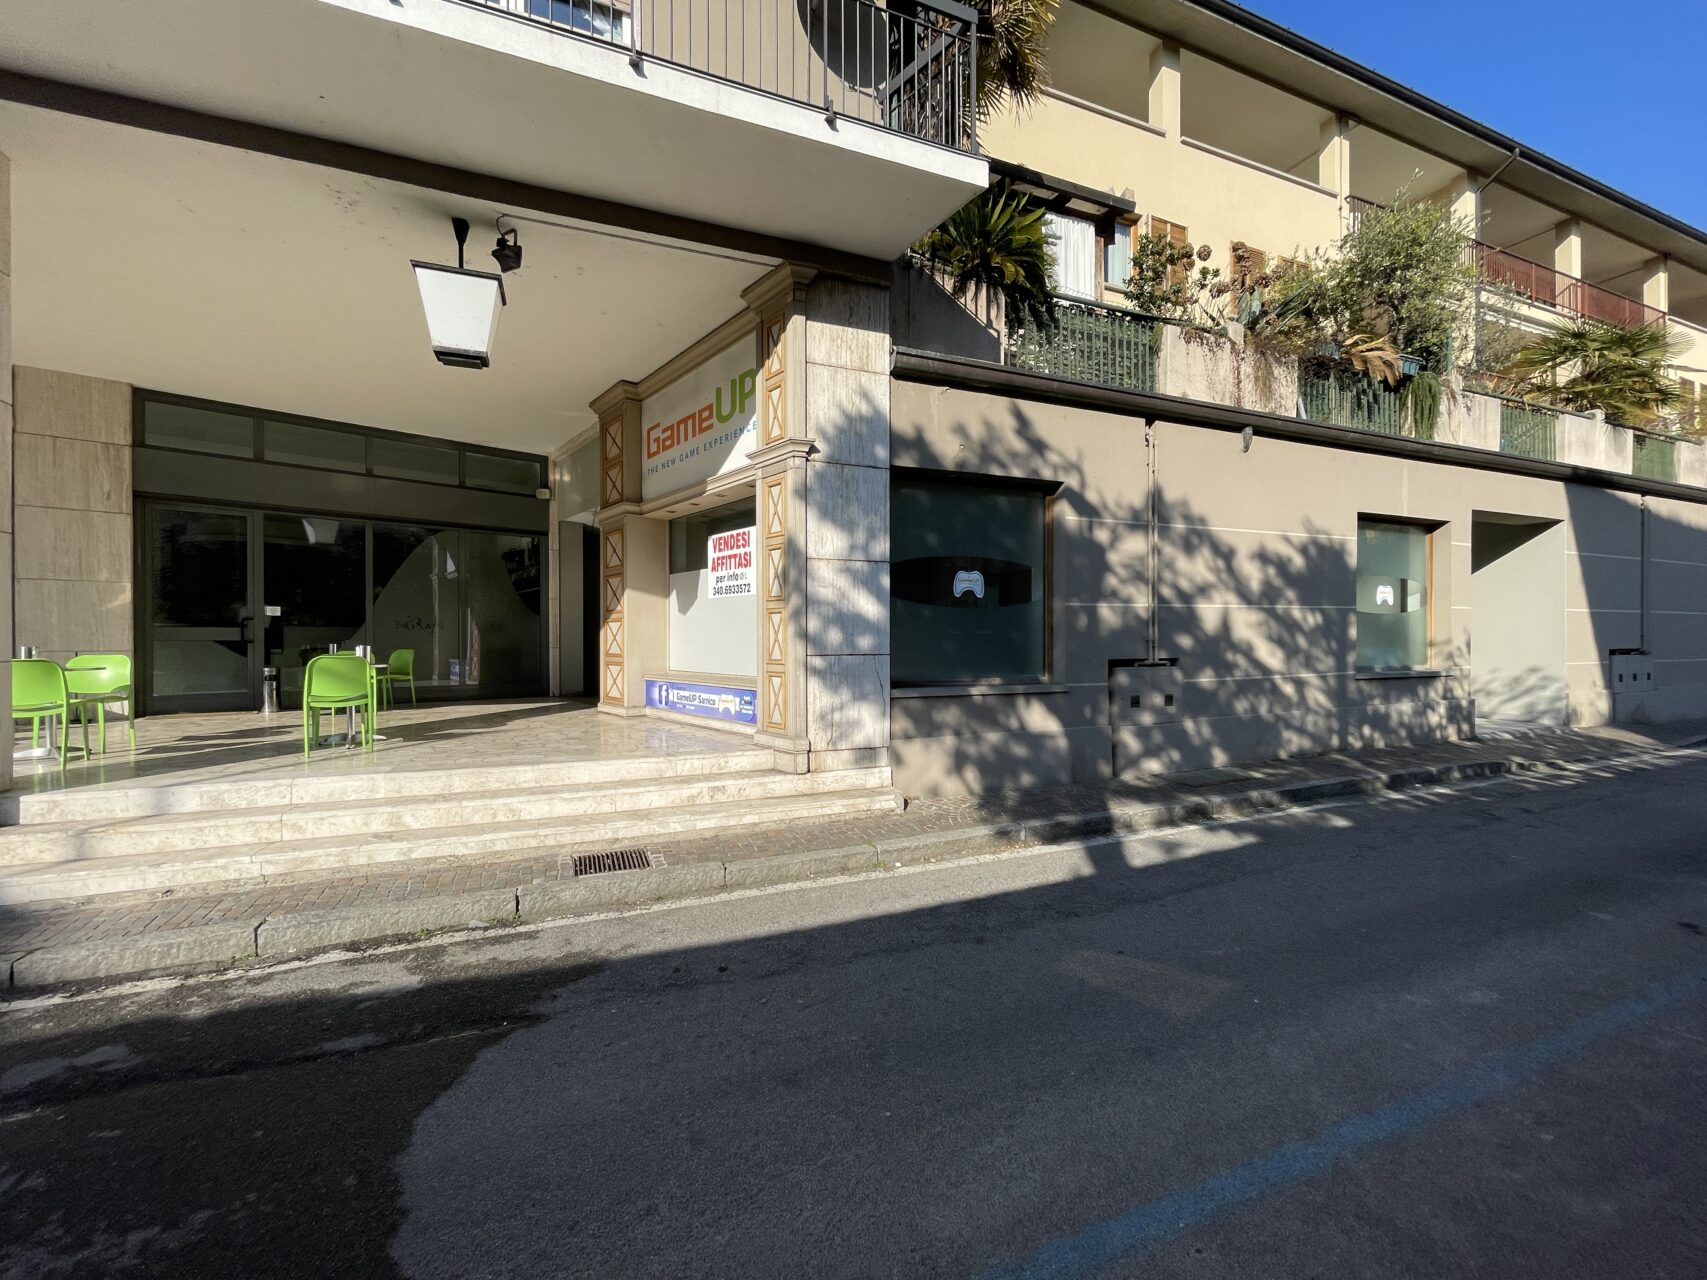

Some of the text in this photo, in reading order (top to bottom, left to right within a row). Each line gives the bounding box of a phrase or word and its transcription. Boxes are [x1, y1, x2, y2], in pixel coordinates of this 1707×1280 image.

[648, 420, 757, 476] THE NEW GAME EXPERIENCE
[712, 530, 751, 554] VENDESI
[711, 551, 752, 573] AFFITTASI
[716, 572, 739, 586] per info
[713, 583, 751, 596] 340.6933572
[676, 692, 697, 703] GameUP
[698, 694, 716, 706] Sarnico
